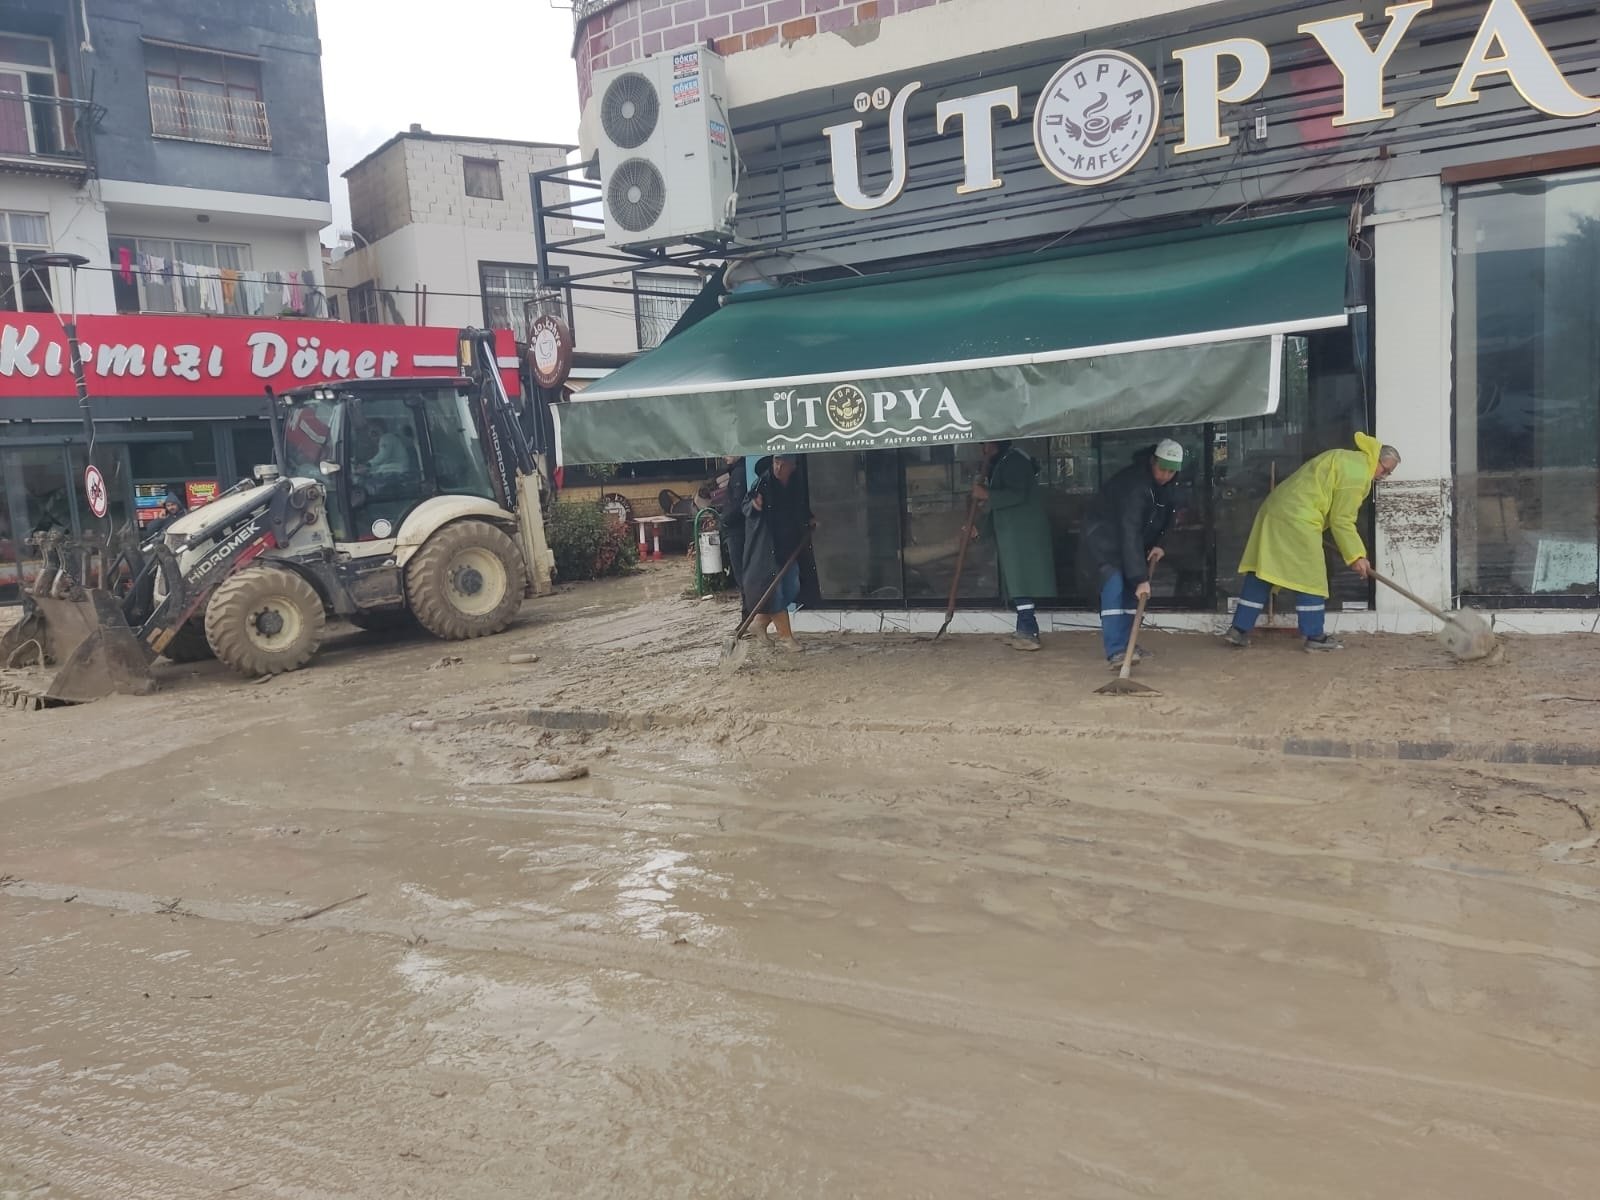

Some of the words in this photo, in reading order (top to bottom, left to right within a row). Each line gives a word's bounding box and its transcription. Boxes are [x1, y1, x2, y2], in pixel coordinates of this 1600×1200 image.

[1045, 63, 1144, 126] ÜTOPYA
[1073, 147, 1121, 171] KAFE
[247, 332, 399, 379] Döner
[884, 437, 902, 445] FAST
[906, 435, 927, 443] FOOD
